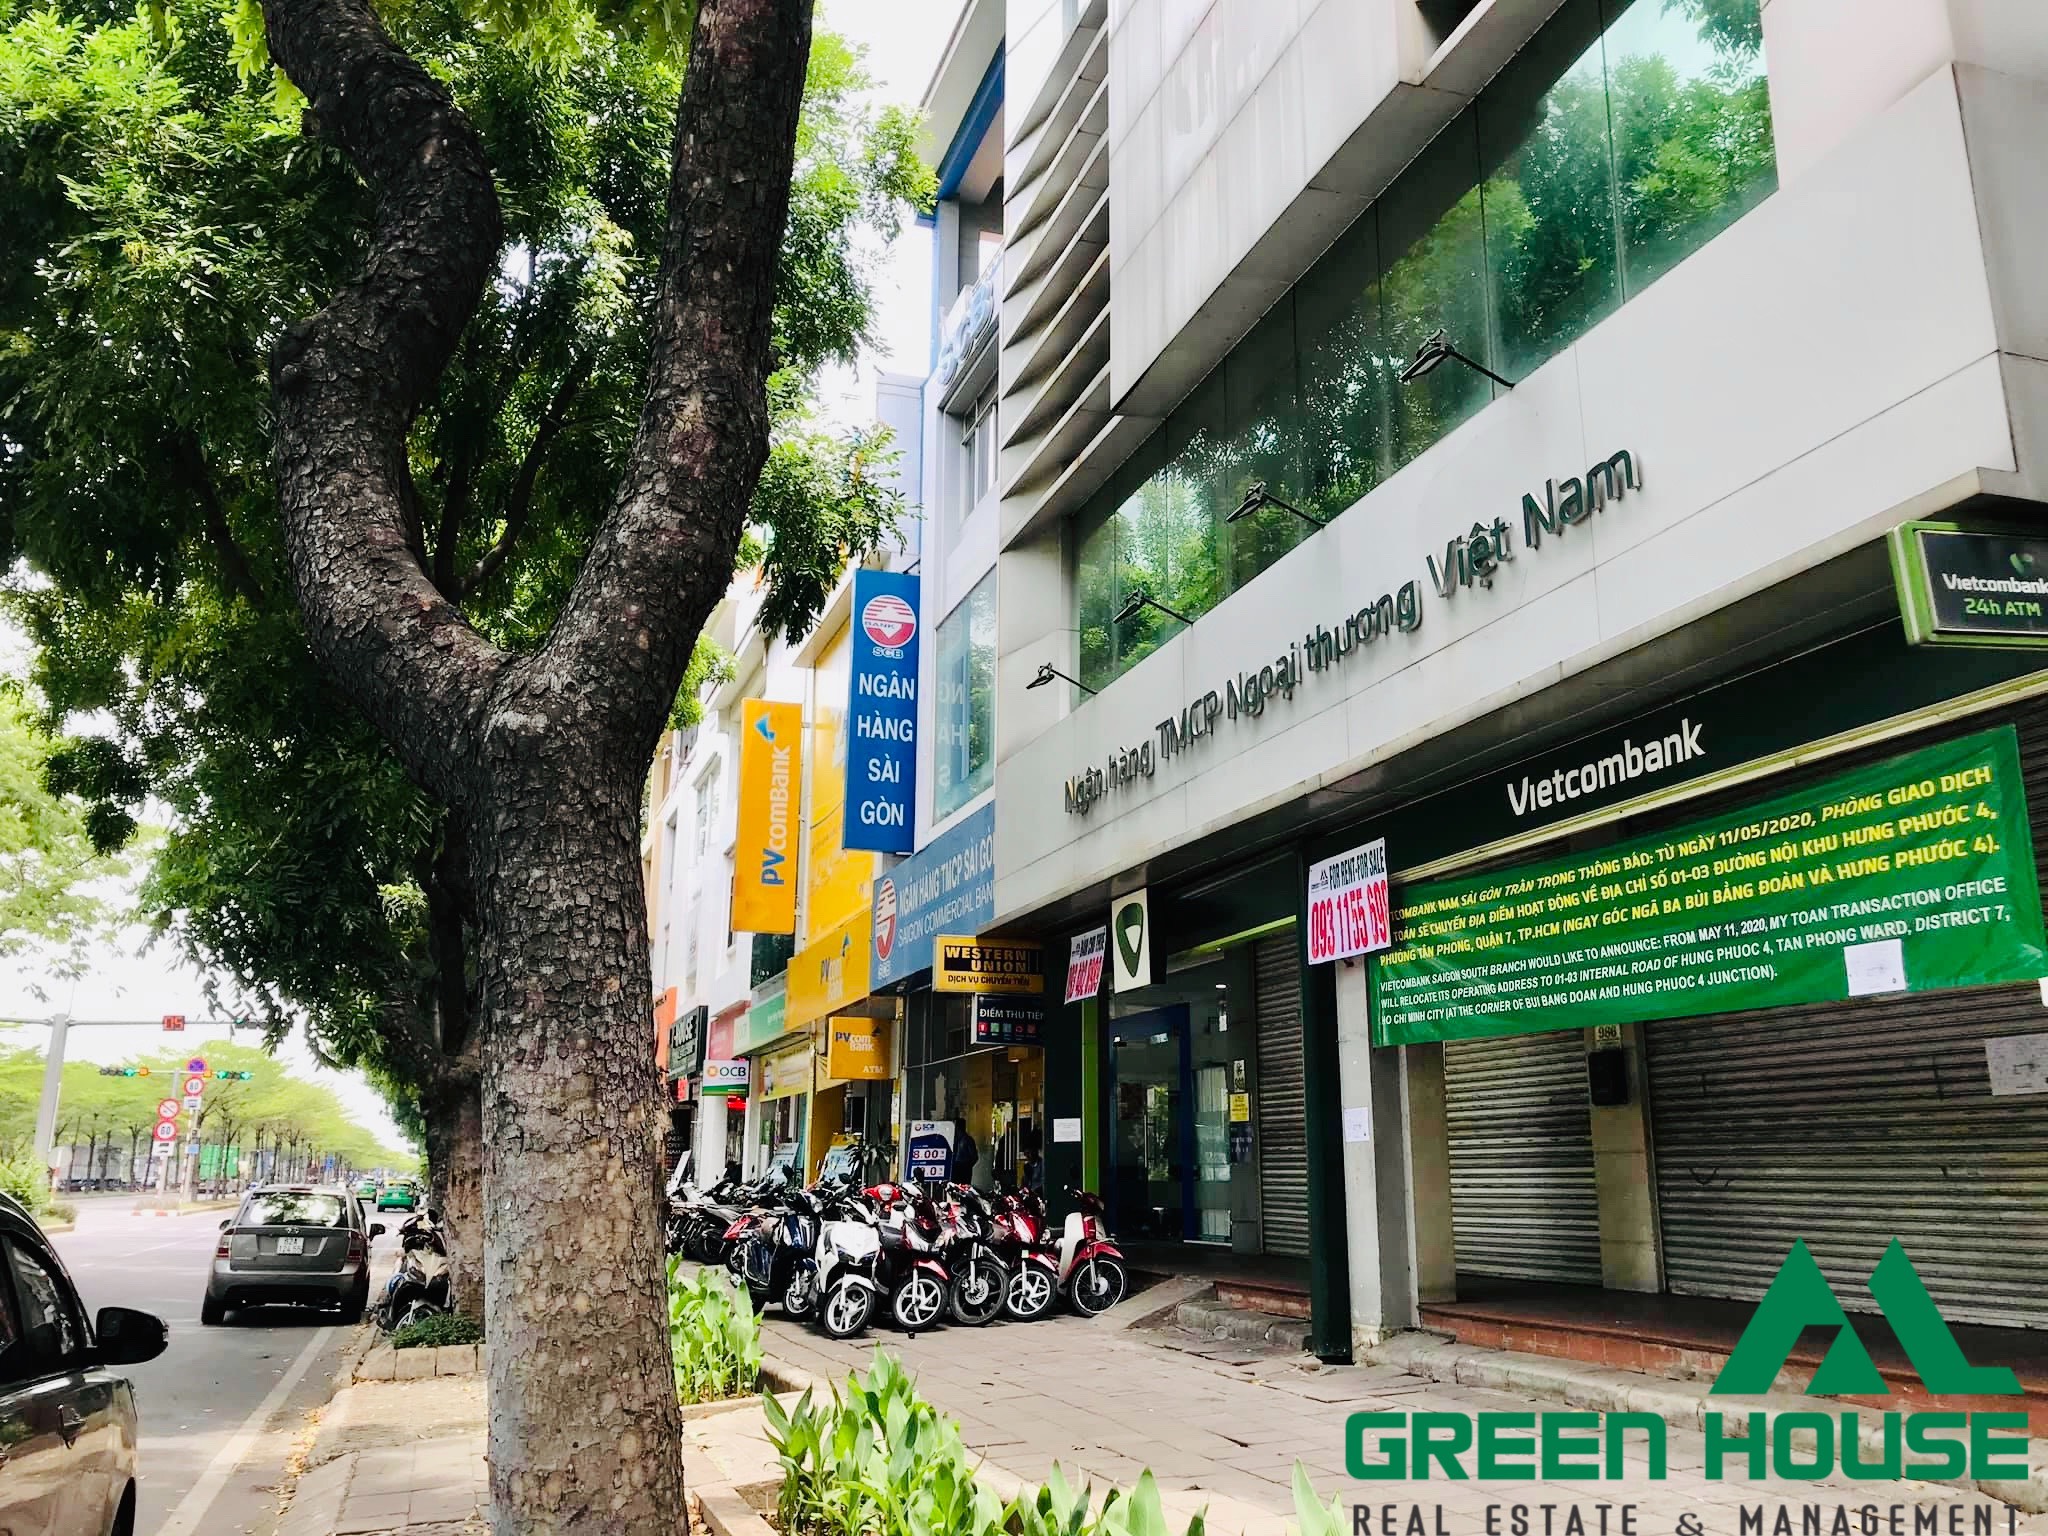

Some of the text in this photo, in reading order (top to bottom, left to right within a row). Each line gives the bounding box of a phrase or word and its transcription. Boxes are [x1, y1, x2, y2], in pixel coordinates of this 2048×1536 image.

[1942, 572, 2048, 595] Vietcombank
[1963, 597, 2042, 617] 24h ATM
[1065, 766, 1108, 816] Ngân
[1109, 741, 1155, 789] hàng
[1156, 690, 1223, 760] TMCP
[1227, 642, 1302, 721] Ngoại
[1426, 516, 1512, 598] Việt
[1522, 449, 1641, 550] Nam
[872, 646, 904, 659] SCB
[859, 671, 915, 700] NGÂN
[857, 710, 913, 742] HÀNG
[868, 754, 900, 783] SÀI
[1507, 718, 1706, 817] Vietcombank
[761, 744, 792, 886] PVcomBank
[860, 795, 904, 826] GÒN
[1439, 896, 1460, 912] NAM
[1461, 890, 1477, 906] SÀI
[1479, 884, 1500, 902] GÒN
[1504, 879, 1534, 897] TRÂN
[1537, 870, 1576, 889] TRỌNG
[1578, 857, 1621, 880] THÔNG
[1623, 851, 1654, 870] BÁO:
[1655, 844, 1675, 862] TỪ
[1677, 834, 1716, 857] NGÀY
[1719, 812, 1817, 846] 11/05/2020,
[1821, 793, 1883, 822] PHÒNG
[1887, 780, 1936, 805] GIAO
[1940, 765, 1992, 792] DỊCH
[899, 876, 918, 918] NGÂN
[919, 865, 940, 905] HÀNG
[942, 856, 962, 891] TMCP
[964, 838, 979, 882] SÀI
[1329, 862, 1341, 891] FOR
[1368, 846, 1385, 877] SALE
[1468, 912, 1486, 928] ĐỊA
[1488, 903, 1514, 923] ĐIỂM
[1517, 900, 1545, 918] HOẠT
[1548, 893, 1580, 911] ĐỘNG
[1581, 884, 1598, 903] VỀ
[1600, 884, 1623, 901] ĐỊA
[1625, 873, 1647, 895] CHỈ
[1650, 867, 1668, 889] SỐ
[1670, 864, 1710, 885] 01-03
[1713, 850, 1767, 875] ĐƯỜNG
[1770, 841, 1798, 864] NỘI
[1802, 834, 1839, 856] KHU
[1842, 822, 1894, 848] HƯNG
[1898, 804, 1971, 835] PHƯỚC
[1975, 801, 1998, 819] 4,
[1418, 945, 1435, 960] TÂN
[1436, 940, 1474, 955] PHONG,
[1475, 932, 1503, 951] QUẬN
[1505, 932, 1516, 945] 7,
[1517, 923, 1560, 941] TP.HCM
[1563, 914, 1600, 935] (NGAY
[1602, 907, 1629, 925] GÓC
[1631, 900, 1659, 920] NGÃ
[1662, 898, 1681, 914] BA
[1685, 888, 1709, 909] BÙI
[1712, 881, 1754, 904] BẰNG
[1758, 871, 1805, 895] ĐOÀN
[1807, 863, 1834, 885] VÀ
[1836, 855, 1890, 880] HƯNG
[1895, 839, 1968, 869] PHƯỚC
[1973, 833, 2000, 854] 4).
[898, 921, 923, 947] SAIGON
[924, 893, 974, 936] COMMERCIAL
[1311, 887, 1368, 959] 093 1155
[1380, 877, 2007, 992] VIETCOMBANK SAIGON SOUTH BRANCH WOULD LIKE TO ANNOUNCE: FROM MAY 11, 2020, MY TOAN TRANSACTION OFFICE
[945, 946, 1027, 961] WESTERN
[971, 960, 1026, 973] UNION
[1381, 905, 2011, 1009] WILL RELOCATE ITS OPERATING ADDRESS TO 01-03 INTERNAL ROAD OF HUNG PHUOC 4, TAN PHONG WARD, DISTRICT 7,
[948, 975, 966, 984] DỊCH
[968, 975, 979, 984] VỤ
[1393, 1012, 1406, 1024] CHI
[1408, 1009, 1425, 1023] MINH
[1426, 1007, 1444, 1020] CITY
[1445, 1005, 1457, 1020] (AT
[1457, 1004, 1474, 1016] THE
[1475, 999, 1512, 1015] CORNER
[1513, 999, 1524, 1011] OF
[1525, 996, 1540, 1008] BUI
[1541, 992, 1568, 1007] BANG
[1569, 988, 1598, 1002] DOAN
[1599, 985, 1620, 1000] AND
[1622, 981, 1653, 996] HUNG
[1655, 975, 1695, 992] PHUOC
[1697, 973, 1705, 986] 4
[1707, 964, 1778, 985] JUNCTION).
[1005, 1010, 1024, 1019] THU
[719, 1066, 747, 1077] OCB
[863, 1065, 884, 1074] ATM
